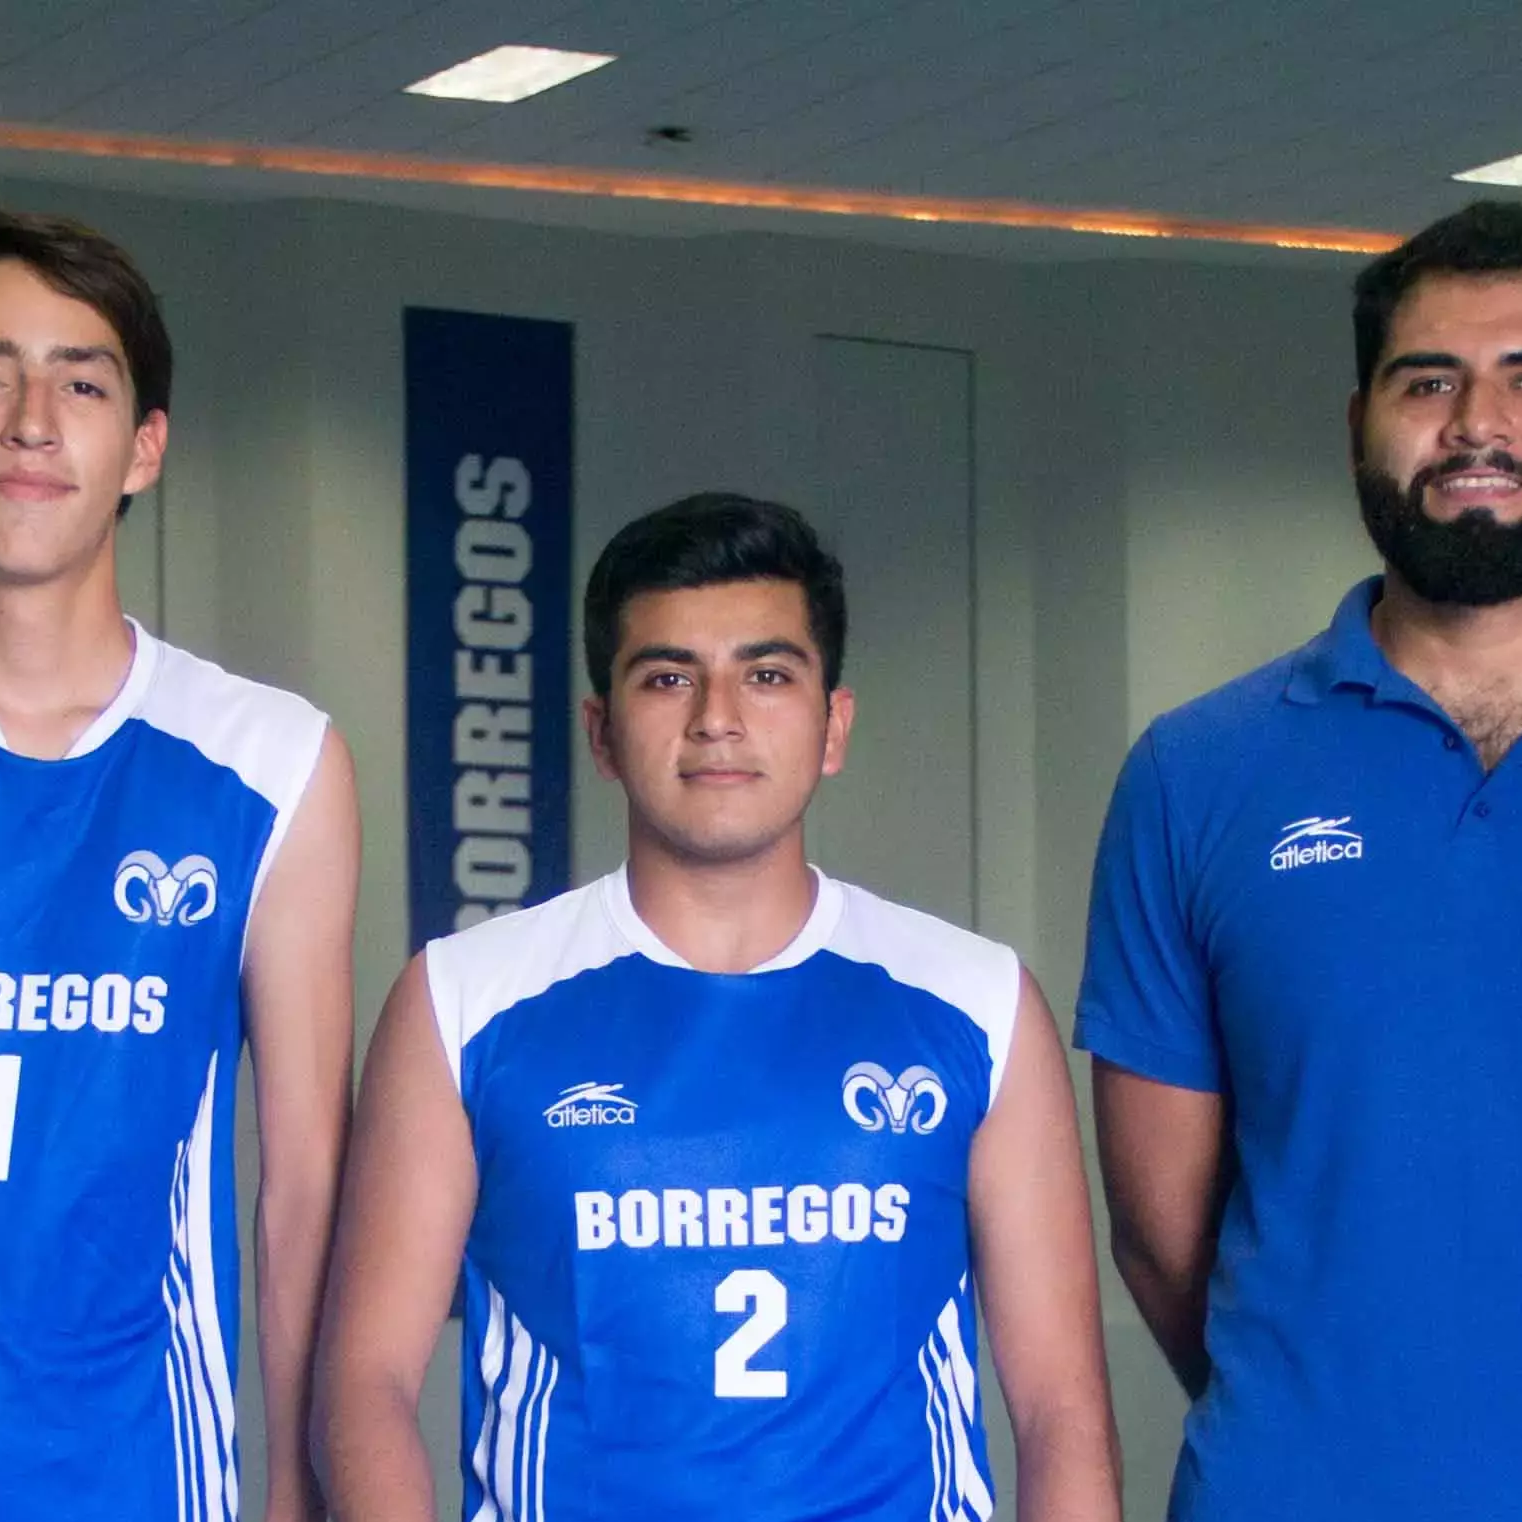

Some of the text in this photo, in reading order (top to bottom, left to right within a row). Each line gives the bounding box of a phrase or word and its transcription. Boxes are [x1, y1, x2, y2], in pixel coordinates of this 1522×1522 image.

[1270, 840, 1363, 871] atletica
[547, 1103, 636, 1129] atletica
[575, 1183, 910, 1251] BORREGOS
[714, 1269, 788, 1398] 2
